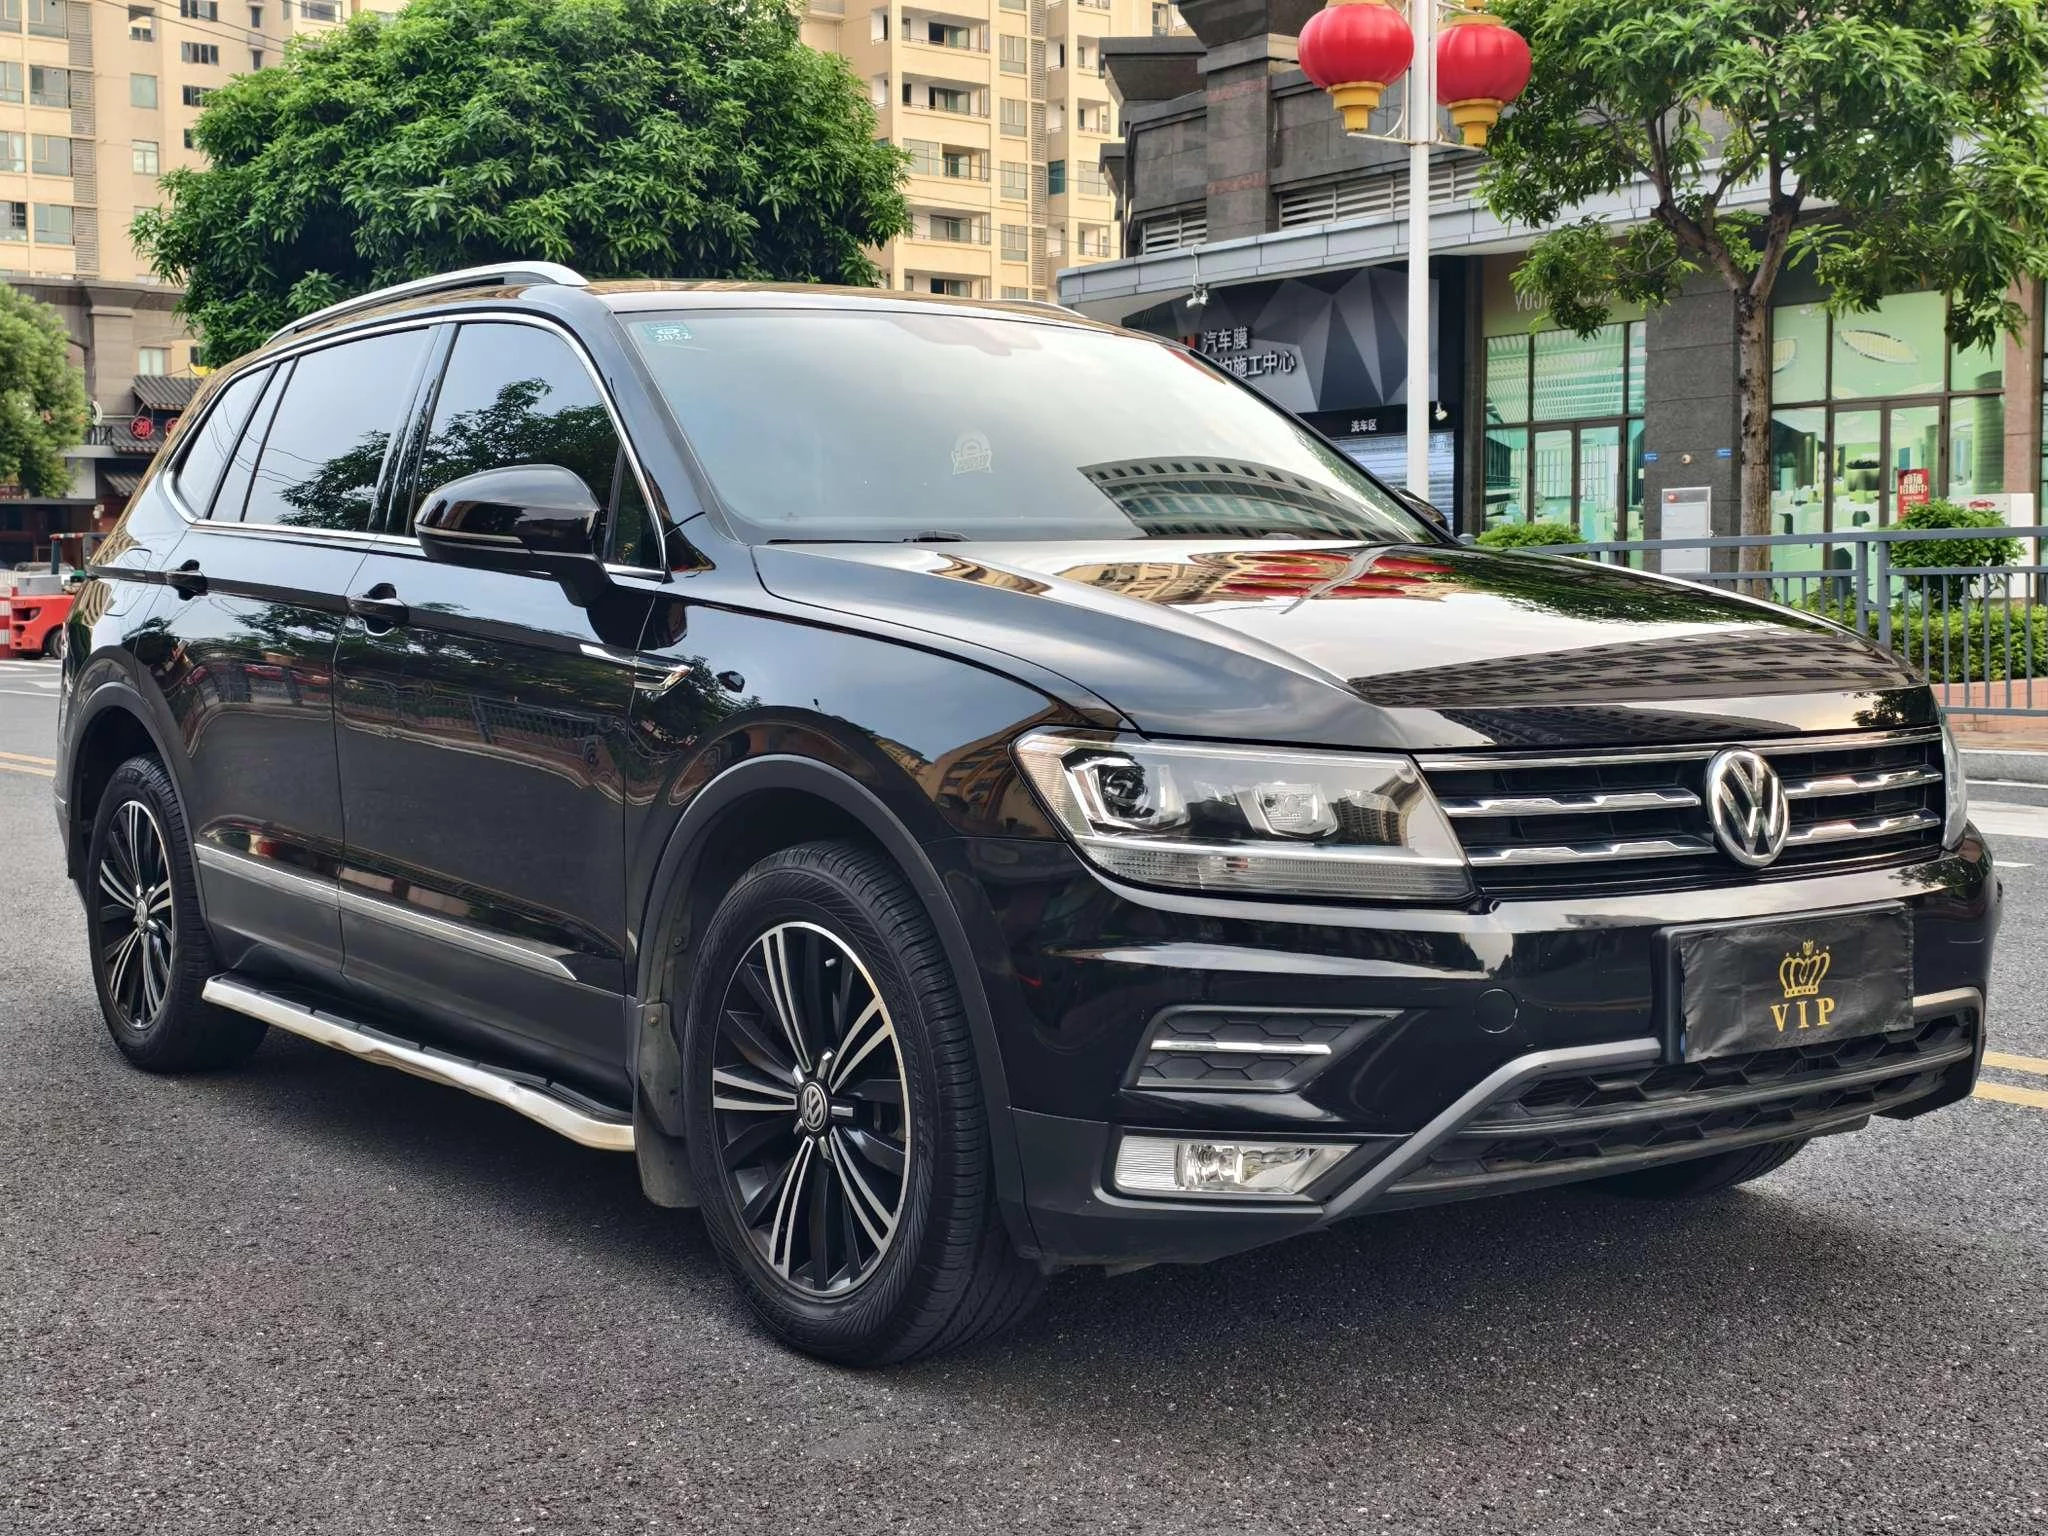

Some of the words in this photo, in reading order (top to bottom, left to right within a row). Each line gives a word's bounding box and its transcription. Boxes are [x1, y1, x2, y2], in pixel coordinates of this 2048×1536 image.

[1203, 327, 1248, 353] 汽车膜
[1770, 998, 1835, 1032] VIP
